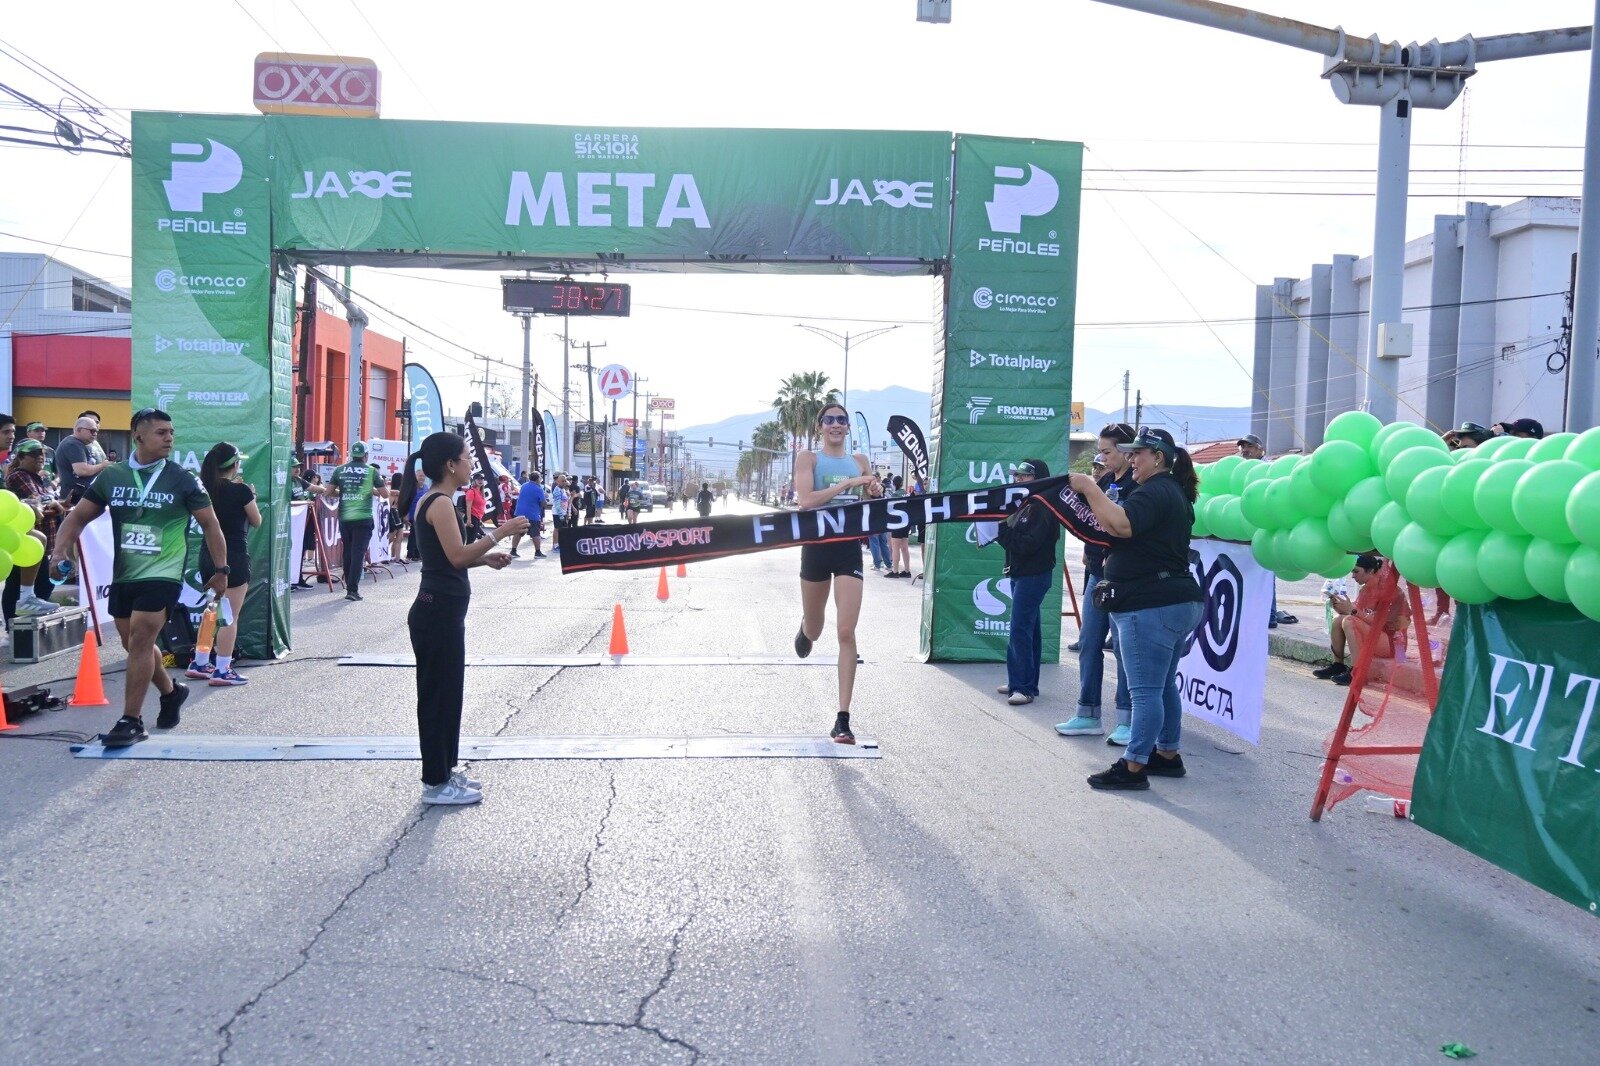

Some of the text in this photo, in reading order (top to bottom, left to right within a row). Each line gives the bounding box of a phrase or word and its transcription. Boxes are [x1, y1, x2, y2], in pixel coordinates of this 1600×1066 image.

[257, 66, 372, 102] OXXO
[574, 133, 639, 142] CARRERA
[505, 171, 711, 228] META
[158, 217, 247, 234] PEÑOLES
[978, 238, 1060, 257] PEÑOLES
[176, 338, 245, 356] Totalplay
[989, 353, 1051, 372] Totalplay
[187, 391, 250, 401] FRONTERA
[997, 405, 1055, 416] FRONTERA
[111, 486, 126, 498] El
[125, 532, 157, 546] 282
[1475, 652, 1556, 751] El
